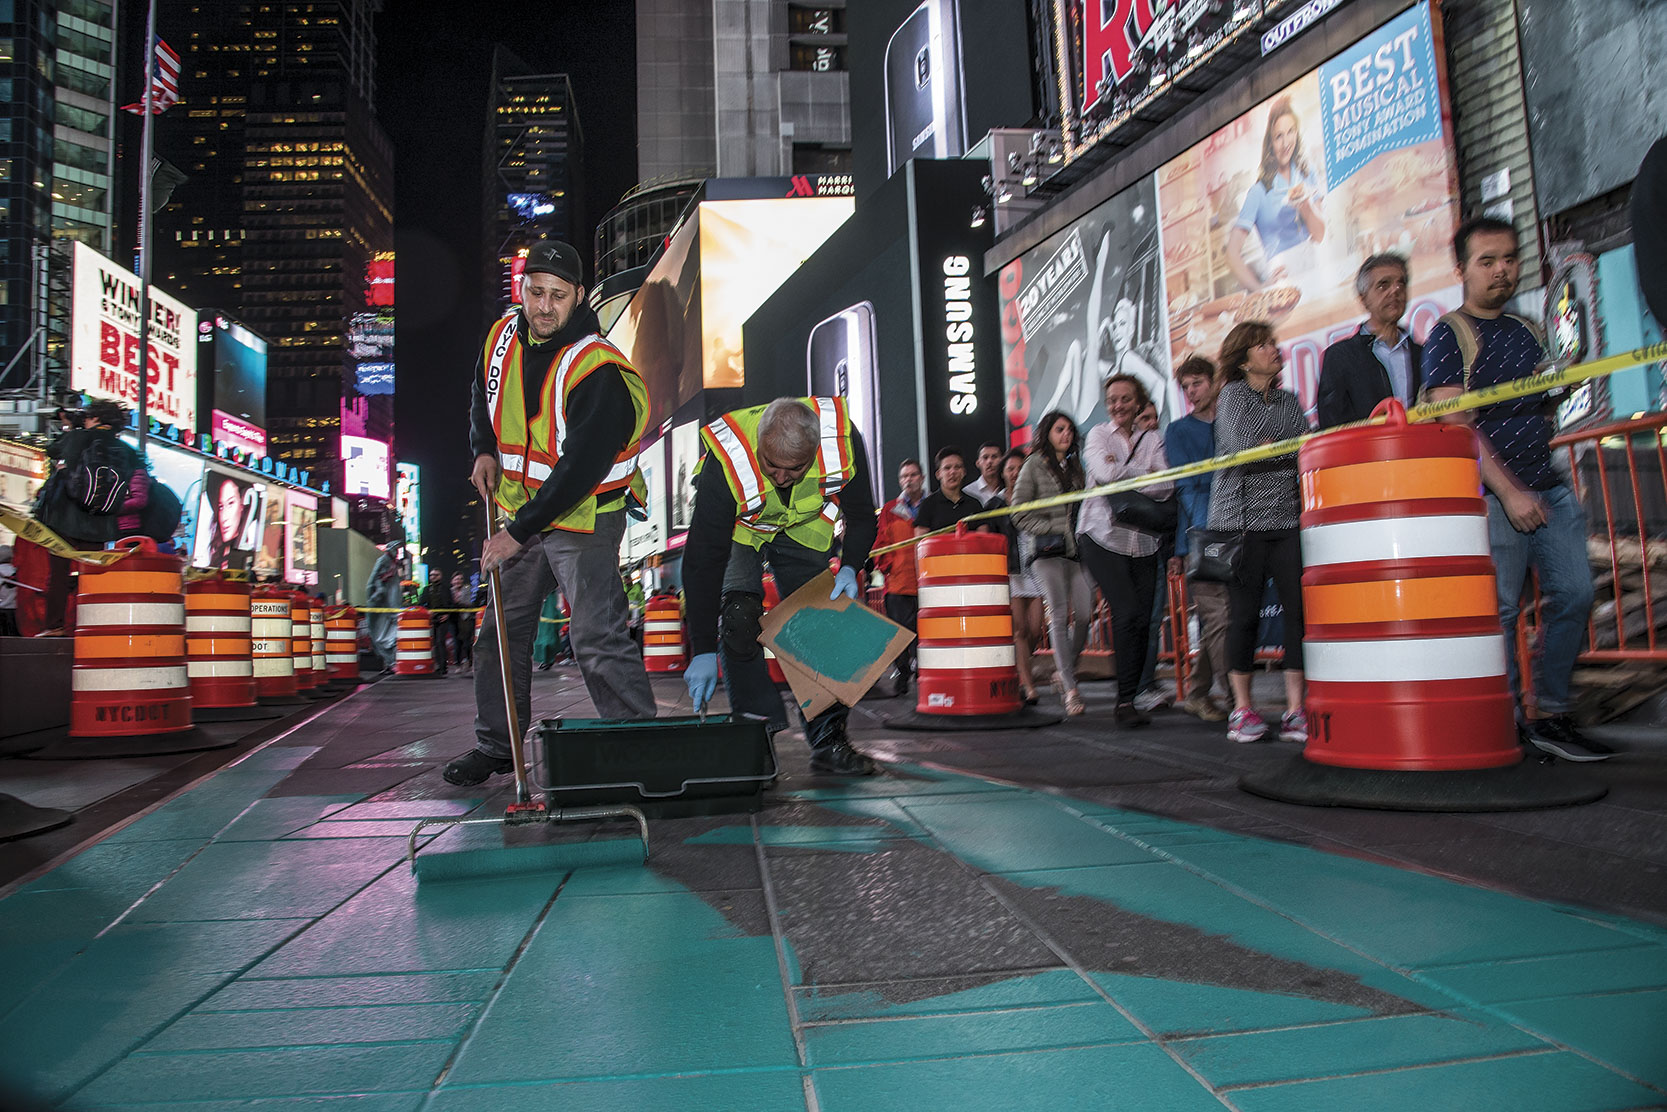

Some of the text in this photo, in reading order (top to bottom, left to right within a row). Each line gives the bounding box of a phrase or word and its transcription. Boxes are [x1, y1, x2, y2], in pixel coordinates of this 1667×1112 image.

[1330, 24, 1418, 114] BEST
[1333, 68, 1424, 135] MUSICAL
[1334, 87, 1427, 148] TONY AWARD
[1335, 102, 1427, 164] NOMINATION
[1020, 285, 1040, 320] 20
[1036, 238, 1080, 297] YEARS
[100, 319, 180, 392] BEST
[487, 323, 517, 404] NYC DOT
[943, 255, 978, 415] SAMSUNG
[98, 365, 181, 419] MUSCAL!
[200, 433, 309, 487] BROADWAY
[238, 487, 268, 552] 21
[95, 703, 170, 722] NYCDOT
